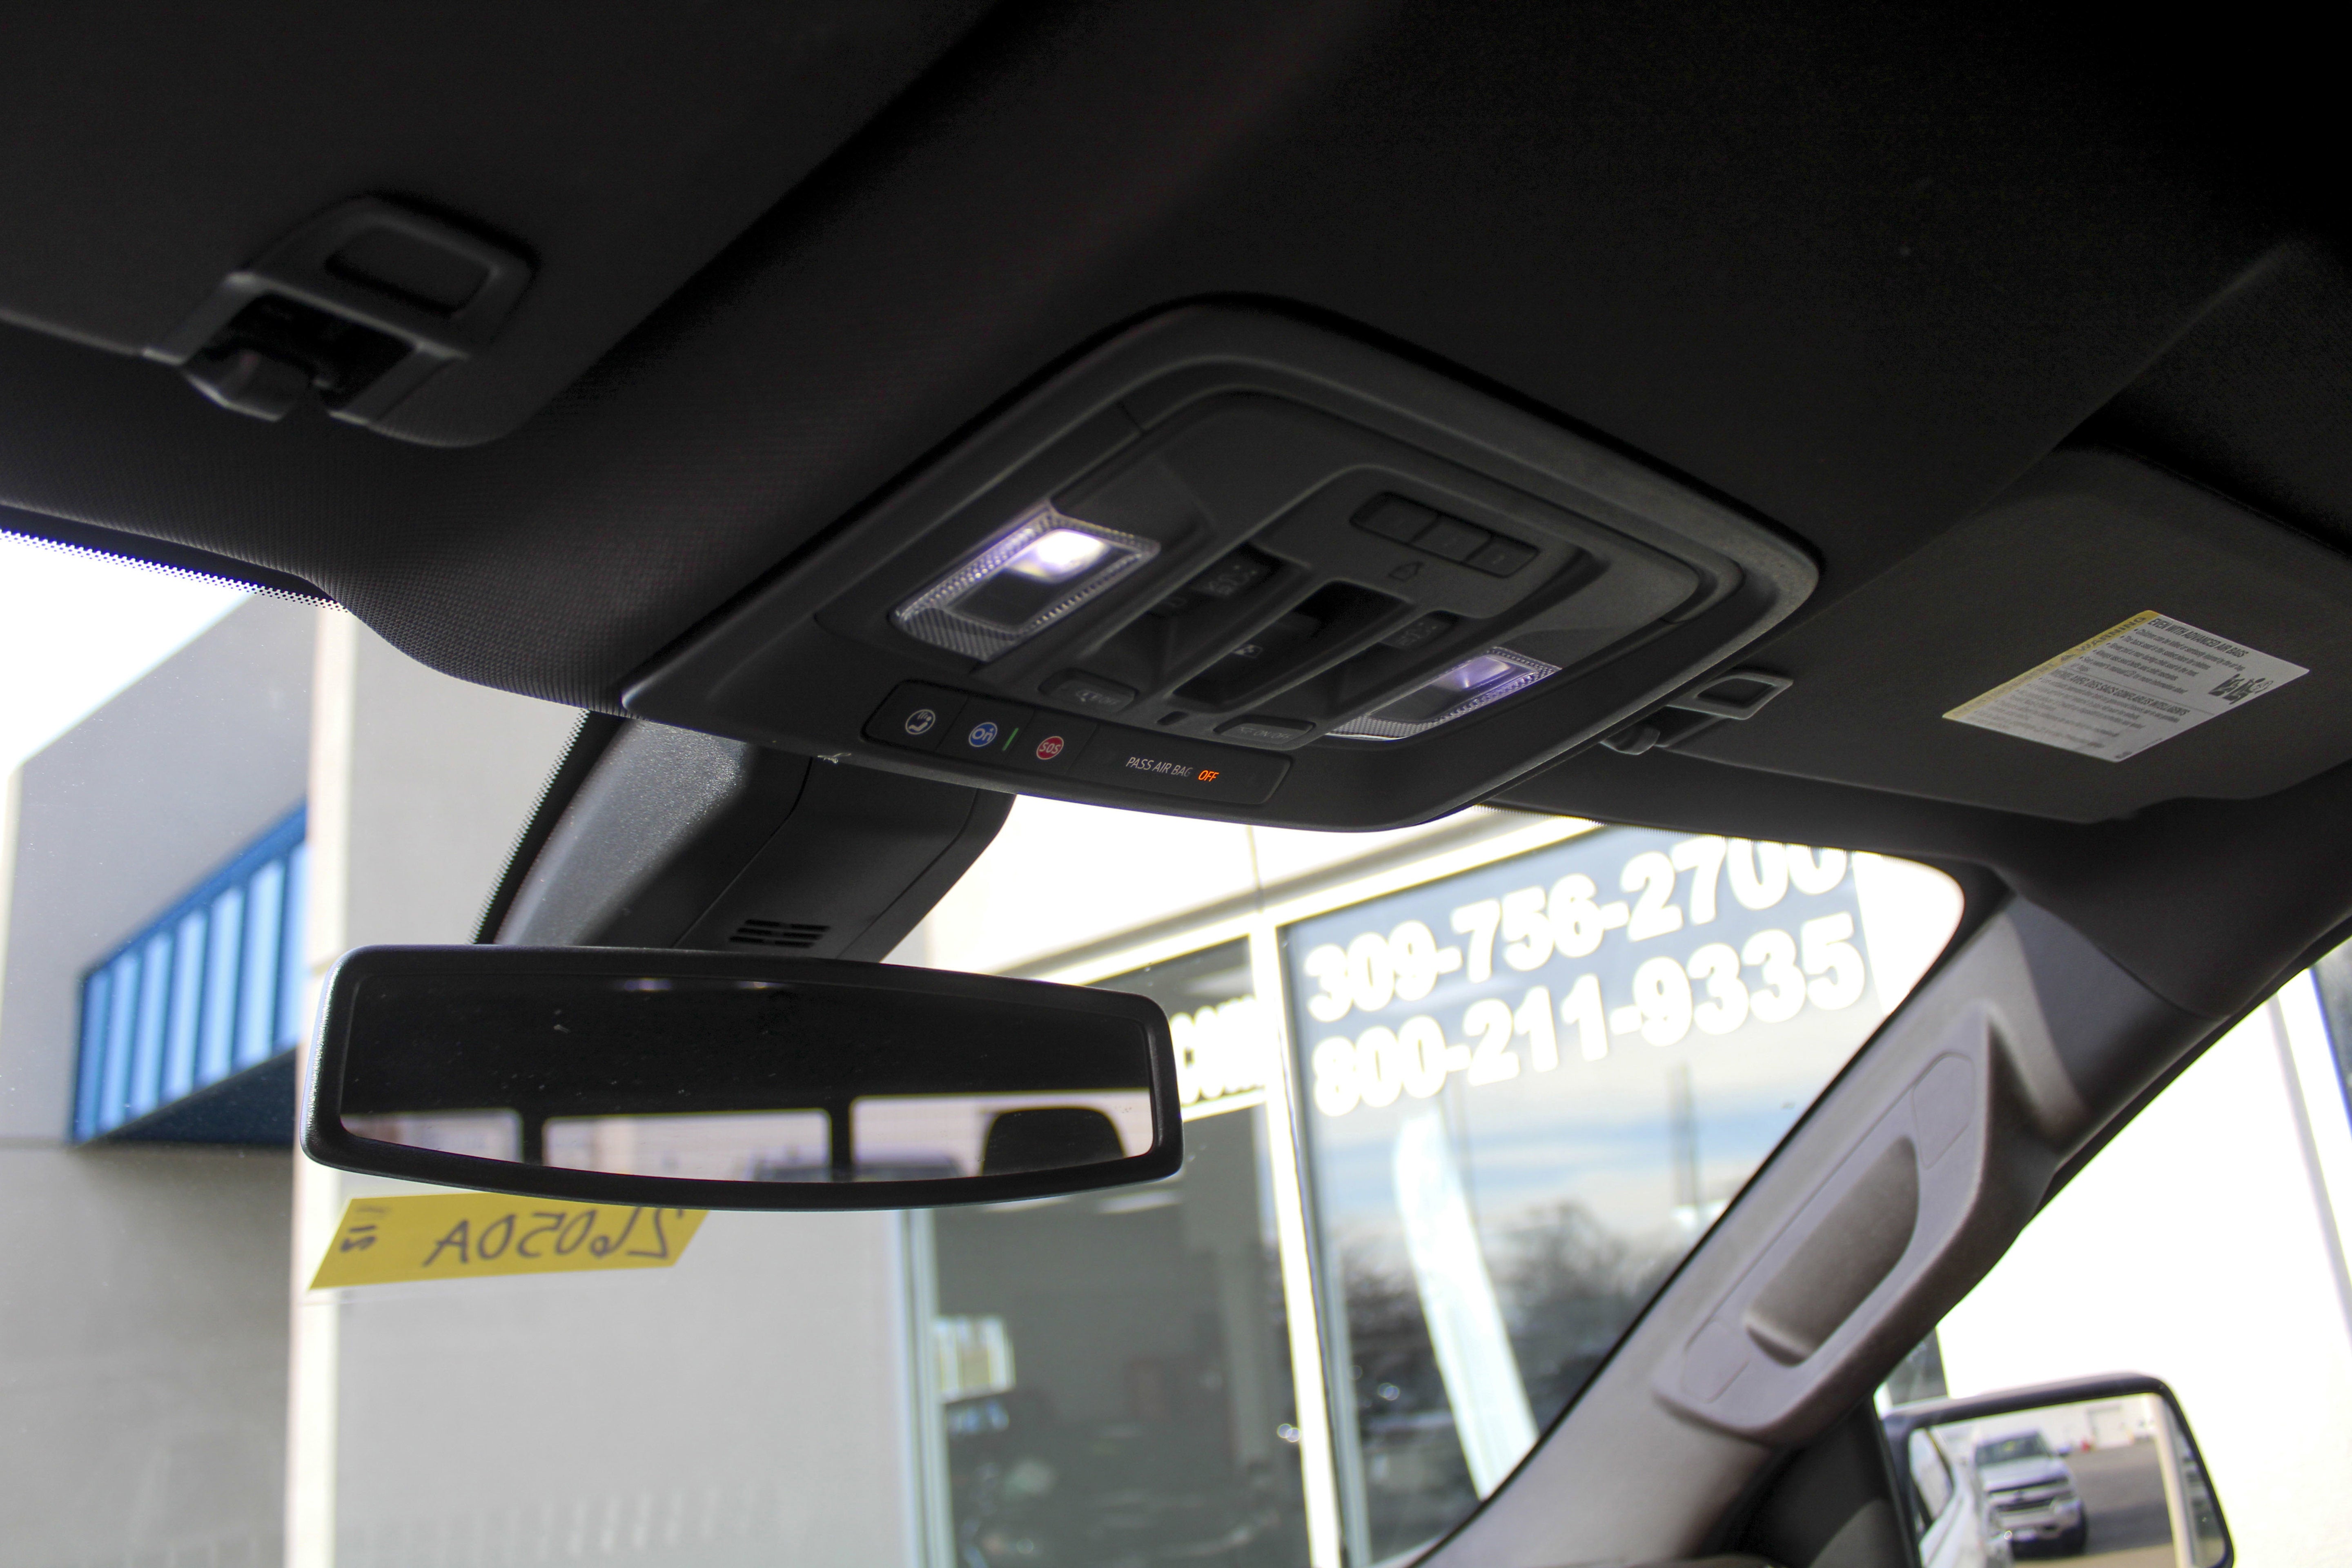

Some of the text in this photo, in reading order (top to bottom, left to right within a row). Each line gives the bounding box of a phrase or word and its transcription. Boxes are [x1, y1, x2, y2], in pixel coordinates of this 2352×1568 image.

[2076, 617, 2145, 651] WARNING
[2148, 618, 2249, 657] EVEN WITH ADVANCED AIR BAGS
[1039, 742, 1061, 754] SOS
[1125, 757, 1219, 782] PASS AIR BAG OFF
[1307, 835, 1847, 1022] 309-756-2700
[1312, 912, 1865, 1116] 800-211-9335
